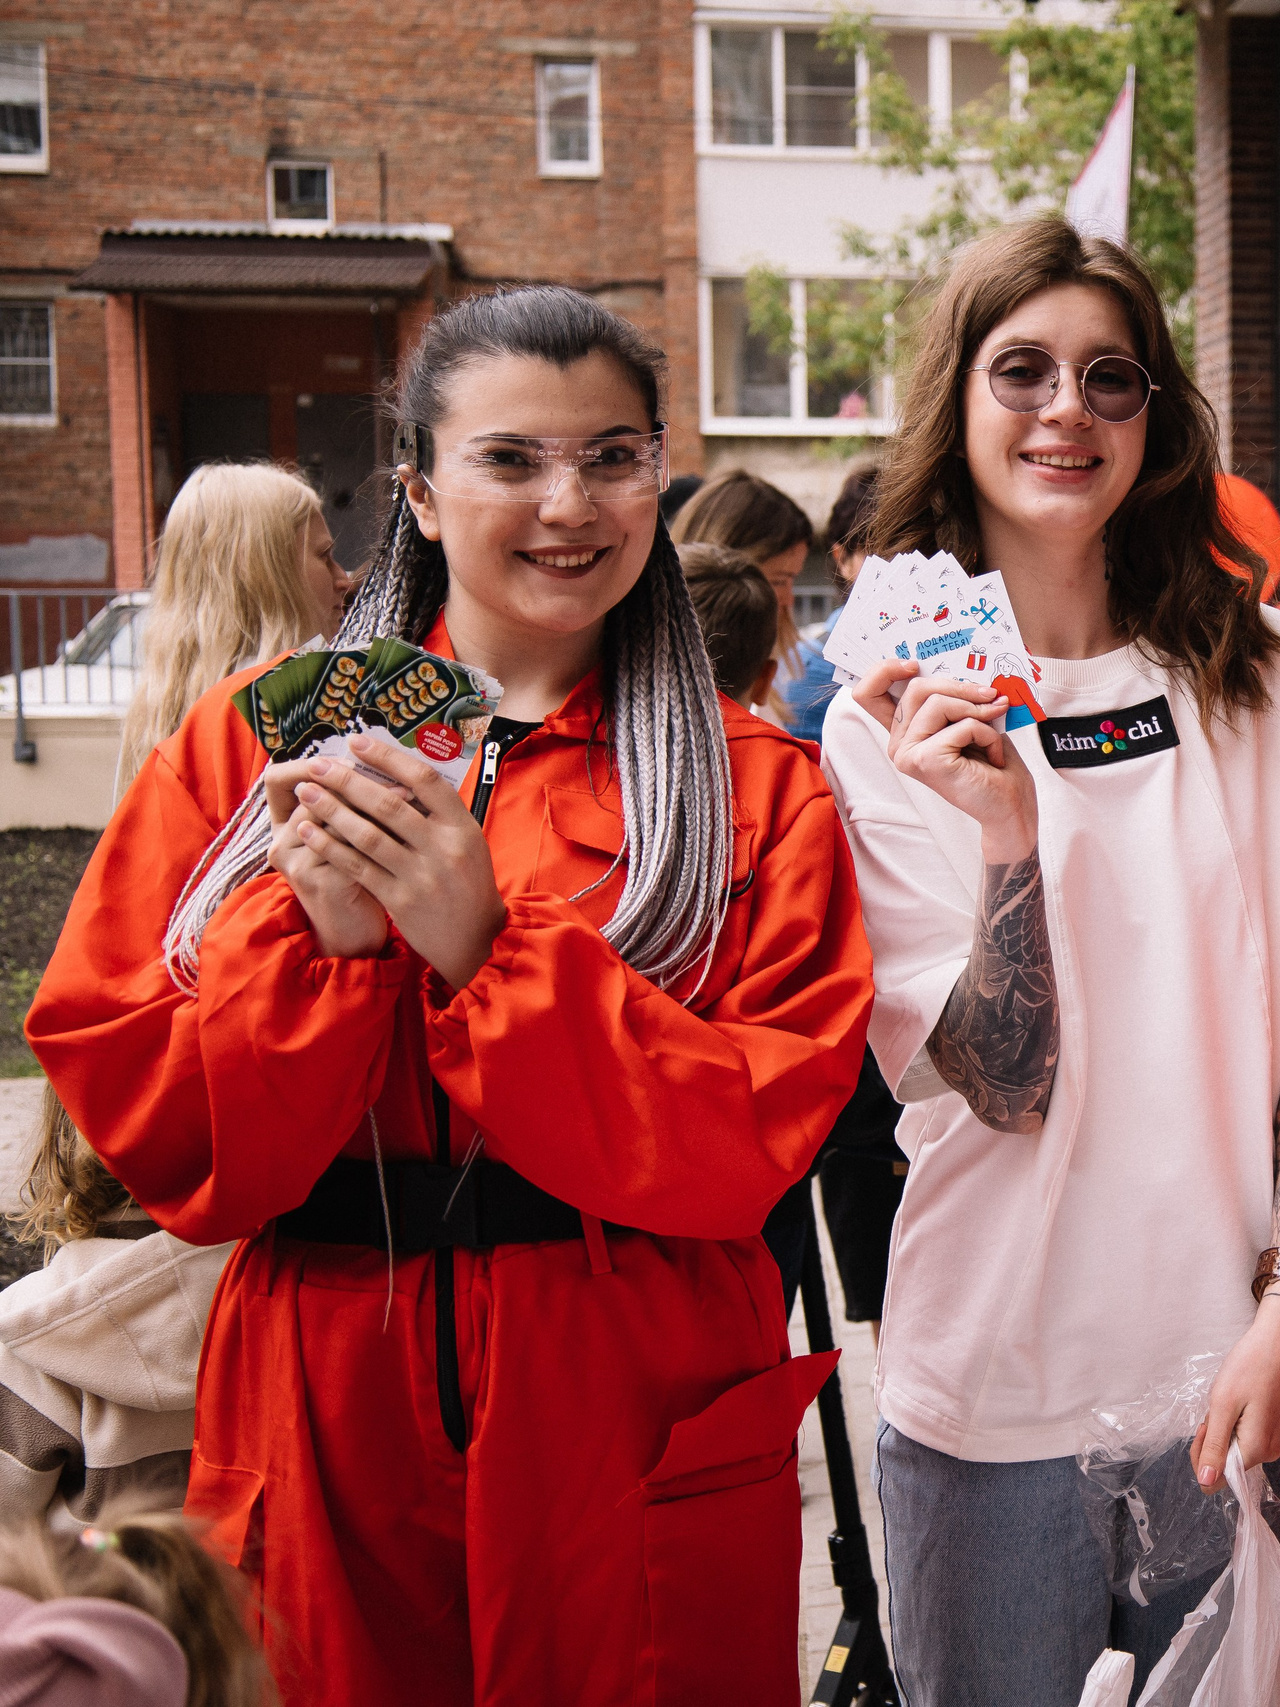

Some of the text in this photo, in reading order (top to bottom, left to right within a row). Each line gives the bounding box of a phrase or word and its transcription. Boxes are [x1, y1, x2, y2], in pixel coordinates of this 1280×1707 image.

[879, 615, 899, 631] kimchi
[907, 612, 930, 624] kimchi
[916, 629, 963, 650] ПОДАРОК
[920, 648, 940, 660] ДЛЯ
